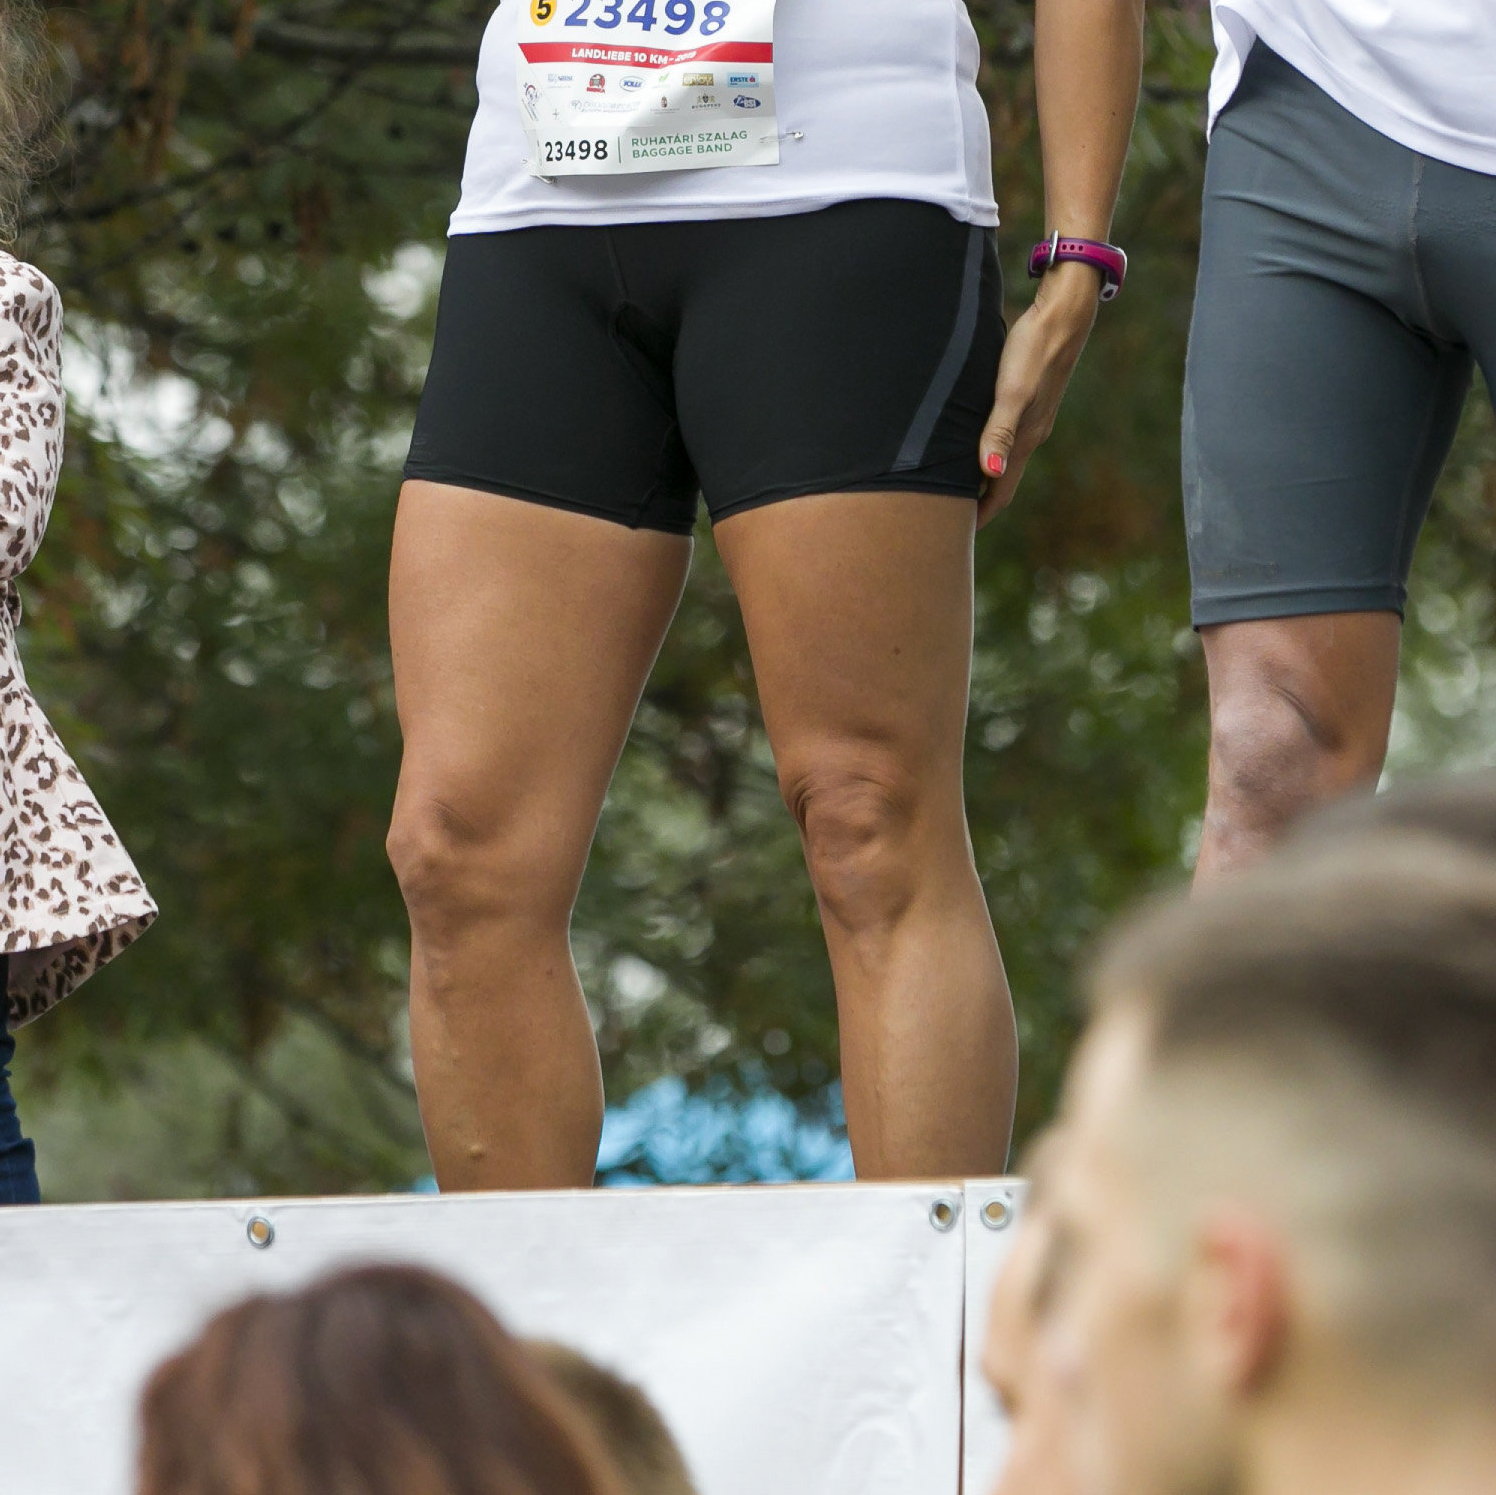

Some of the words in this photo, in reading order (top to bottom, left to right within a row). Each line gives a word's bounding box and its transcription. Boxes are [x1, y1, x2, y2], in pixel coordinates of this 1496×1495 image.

[572, 47, 632, 62] LANDLIEBE
[634, 52, 647, 62] 10
[649, 54, 669, 65] KM
[631, 131, 695, 147] RUHATÁRI
[698, 129, 749, 143] SZALAG
[545, 138, 610, 163] 23498
[632, 145, 694, 159] BAGGAGE
[696, 143, 734, 155] BAND
